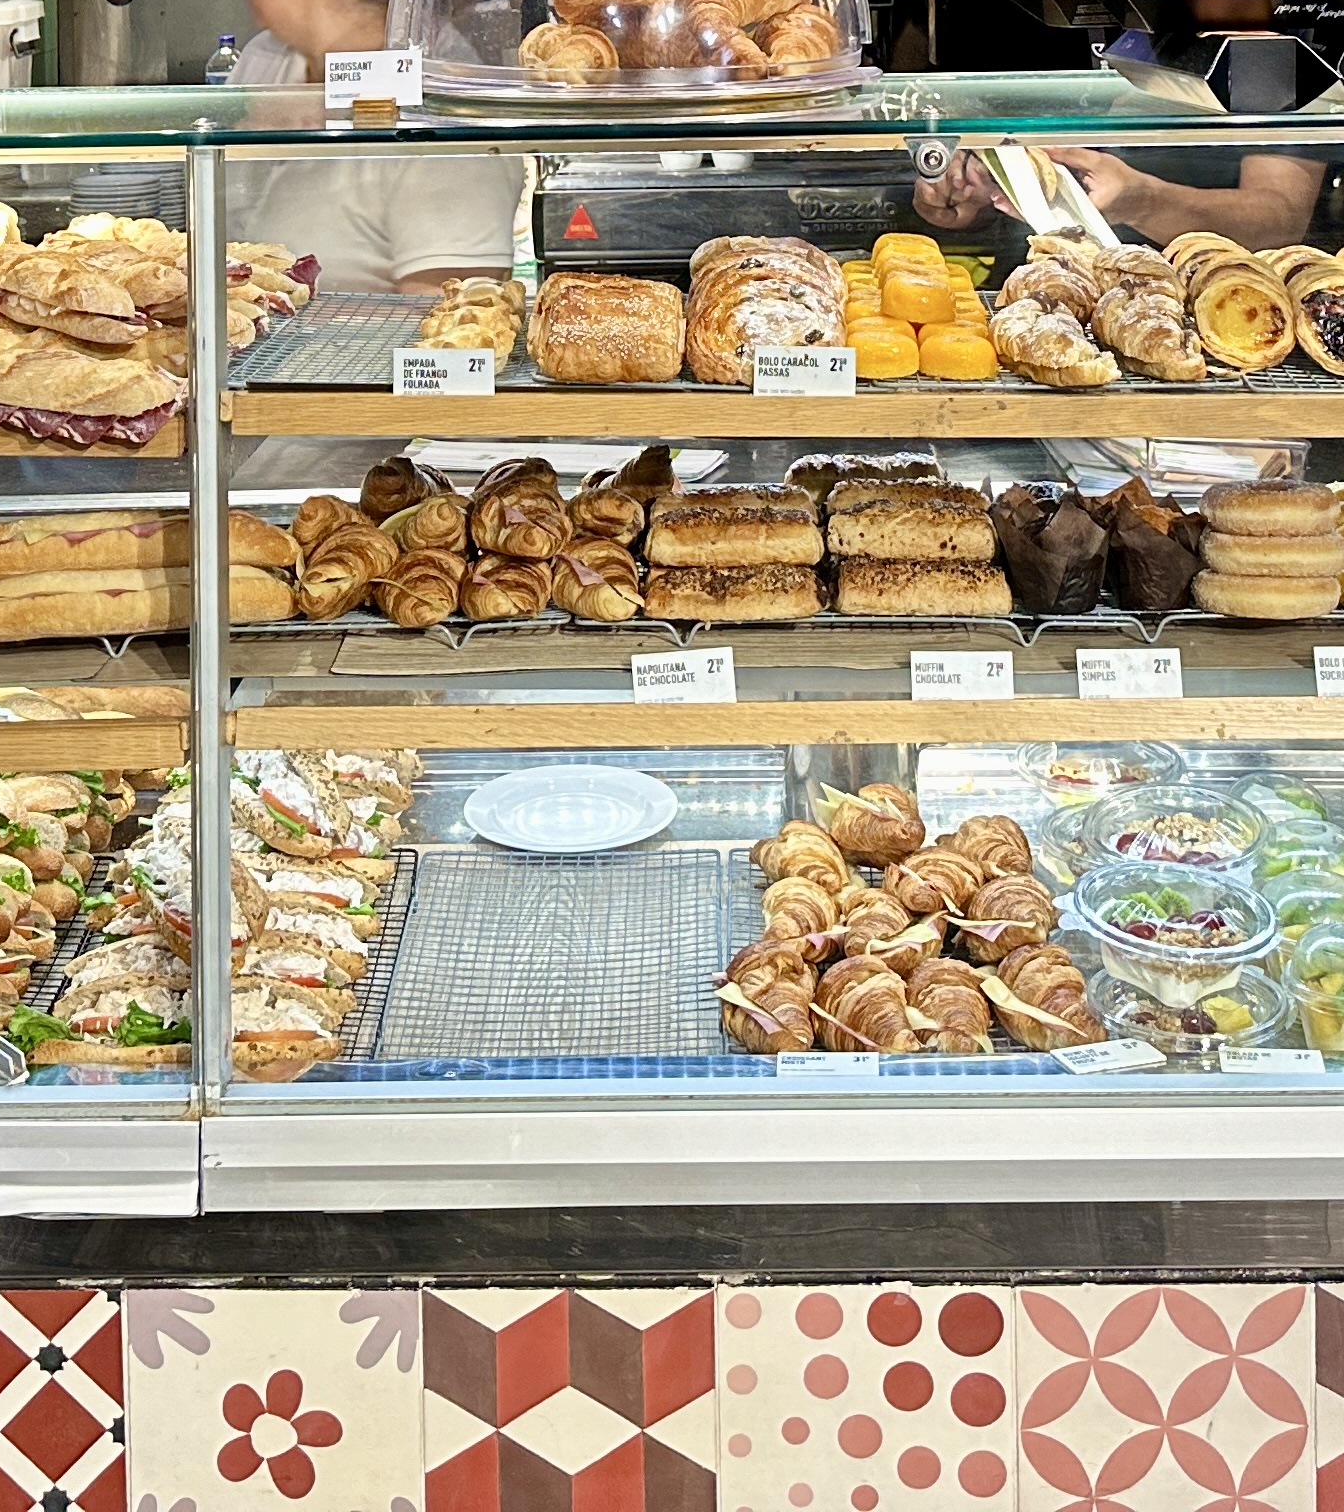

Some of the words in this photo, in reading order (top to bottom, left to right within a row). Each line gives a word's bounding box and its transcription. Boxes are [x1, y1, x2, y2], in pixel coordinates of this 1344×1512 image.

[329, 60, 373, 72] CROISSANT
[329, 72, 362, 83] SIMPLES
[403, 358, 436, 368] EMPADA
[758, 356, 779, 367] BOLO
[403, 369, 414, 379] DE
[415, 368, 448, 379] FRANGO
[758, 367, 790, 378] PASSAS
[914, 662, 945, 673] MUFFIN
[1081, 659, 1111, 670] MUFFIN
[1318, 657, 1340, 668] BOLO
[636, 662, 687, 677] NAPOLITANA
[637, 675, 649, 687] DE
[650, 673, 696, 687] CHOCOLATE
[915, 673, 962, 685] CHOCOLATE
[1081, 670, 1117, 681] SIMPLES
